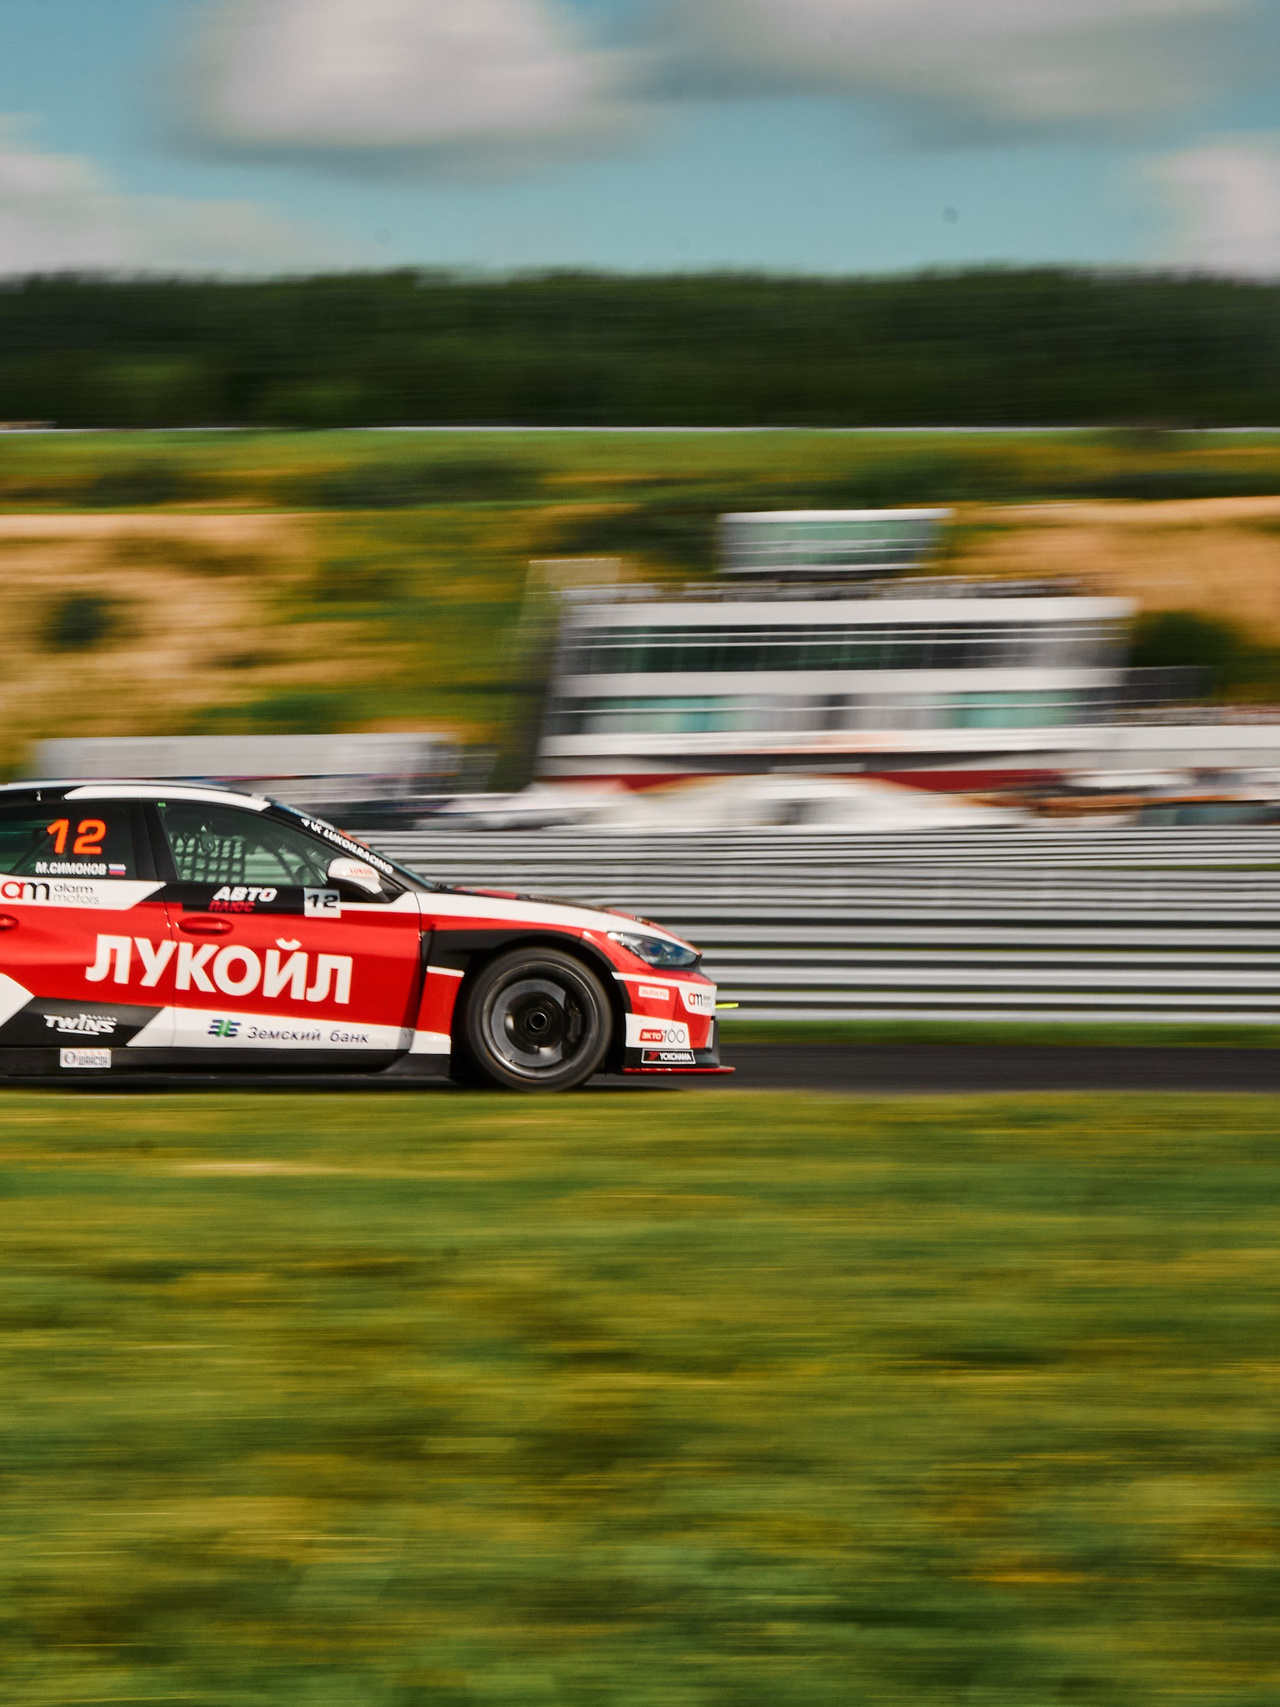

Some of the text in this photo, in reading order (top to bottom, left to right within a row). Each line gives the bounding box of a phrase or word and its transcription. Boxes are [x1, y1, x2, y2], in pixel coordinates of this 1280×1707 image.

[46, 818, 107, 855] 12
[35, 861, 108, 876] М.СИМОНОВ
[53, 883, 94, 894] alarm
[212, 886, 278, 902] АВТО
[53, 893, 100, 906] motors
[208, 899, 256, 913] ПЛЮС
[307, 894, 339, 909] 12
[85, 934, 353, 1004] ЛУКОЙЛ
[43, 1013, 117, 1034] TWINS
[247, 1026, 370, 1044] Земский банк
[659, 1052, 692, 1061] YOKOHAMA
